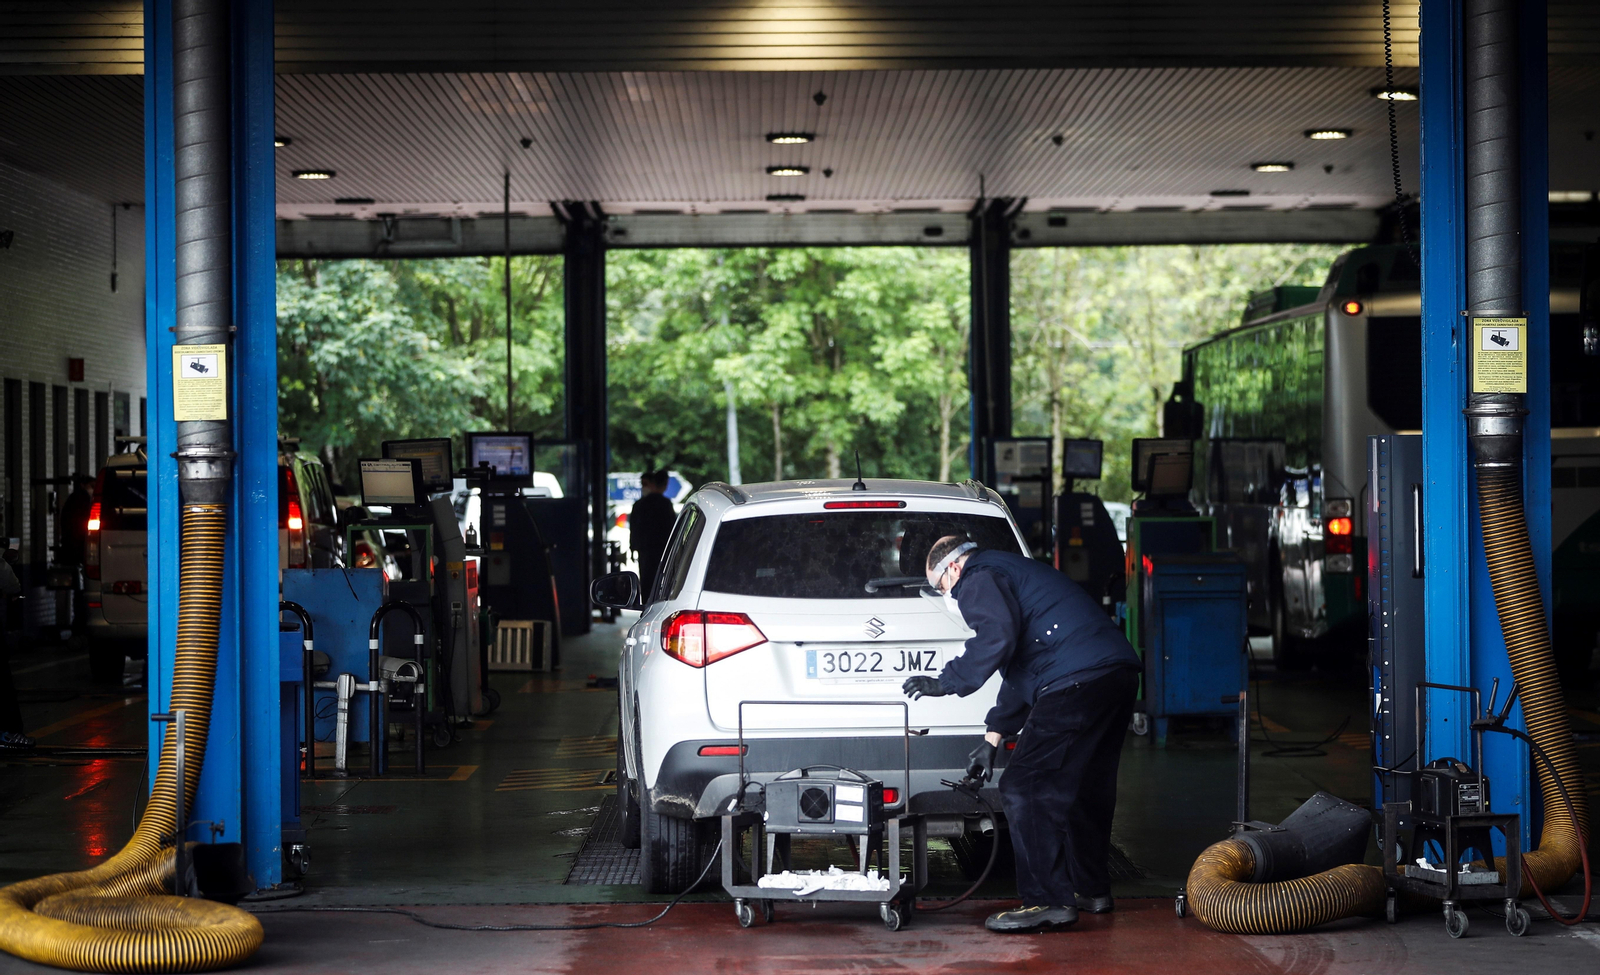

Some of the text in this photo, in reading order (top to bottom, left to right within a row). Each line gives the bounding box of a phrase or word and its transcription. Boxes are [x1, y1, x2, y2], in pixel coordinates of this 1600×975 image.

[822, 650, 938, 673] 3022 JMZ
[809, 666, 815, 674] E
